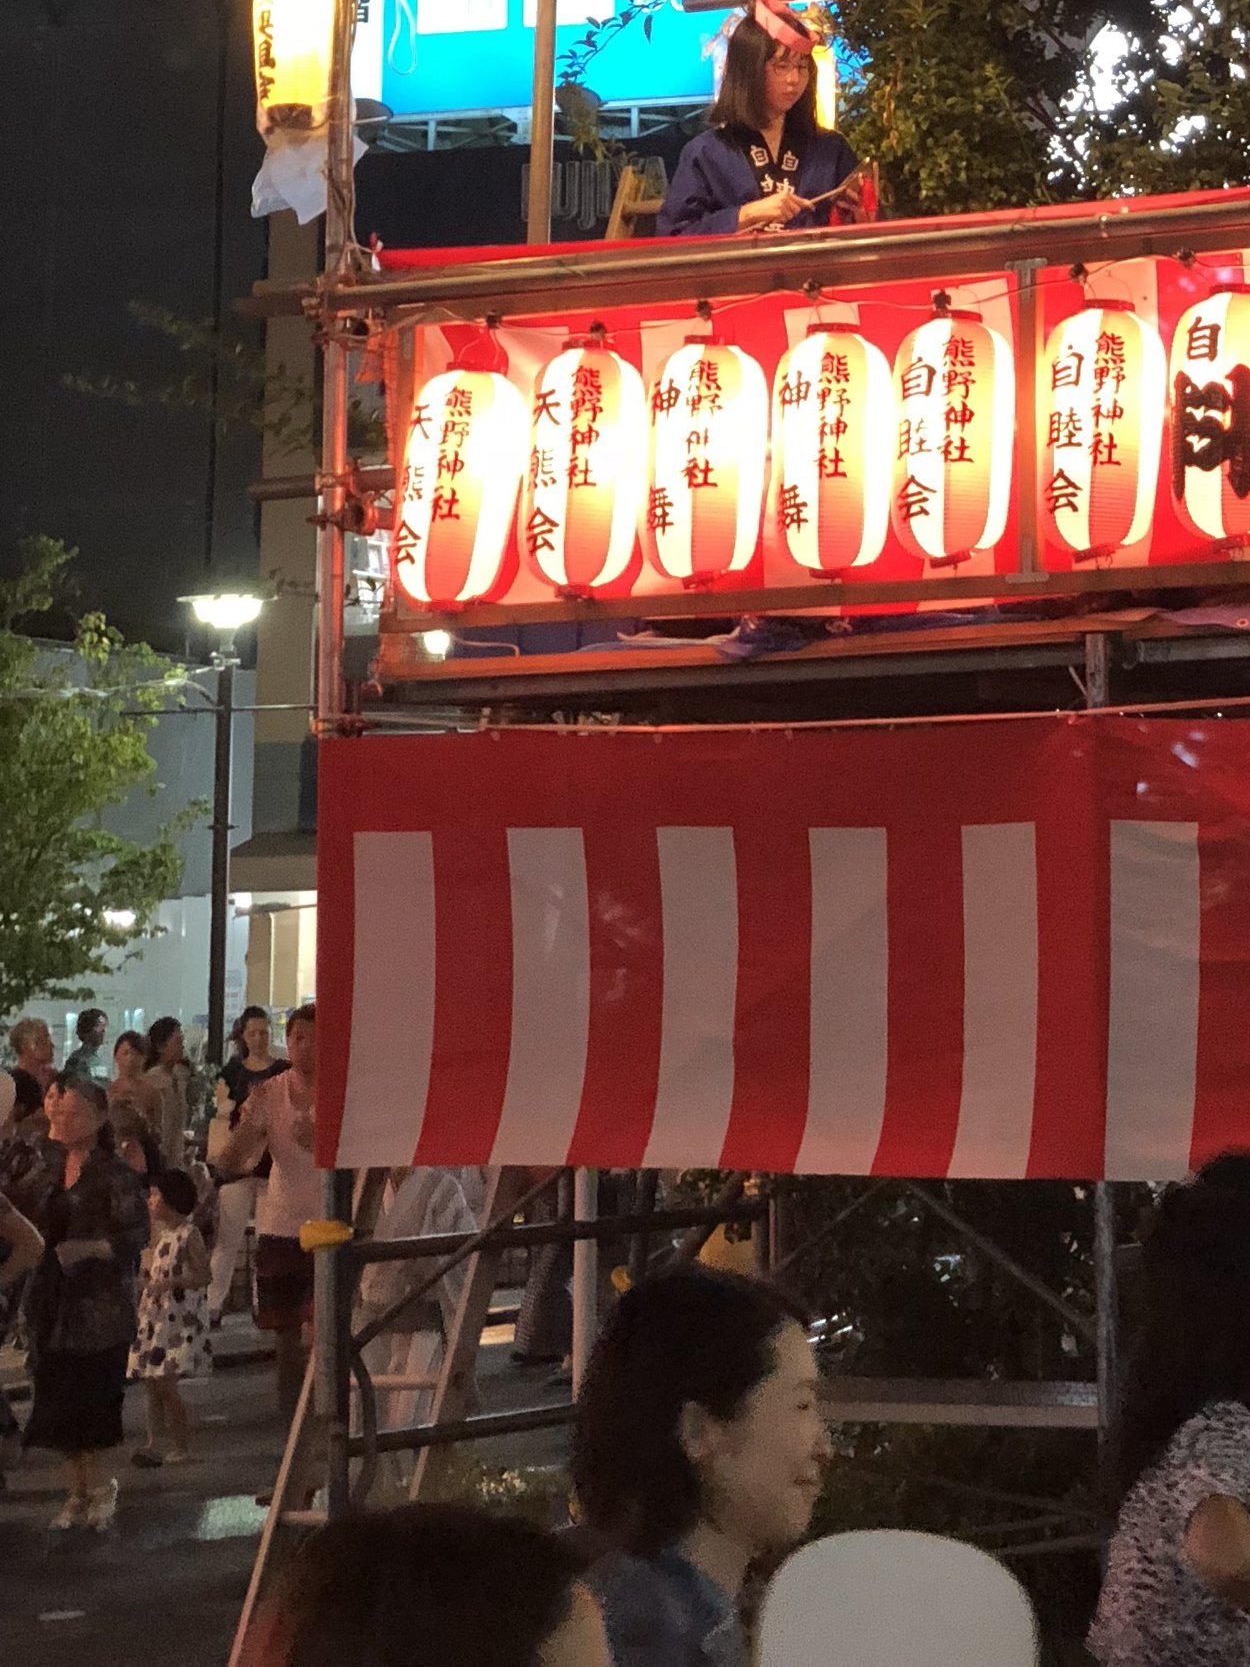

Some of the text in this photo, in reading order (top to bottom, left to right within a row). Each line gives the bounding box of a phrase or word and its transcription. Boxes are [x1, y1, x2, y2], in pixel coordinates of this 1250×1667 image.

[430, 386, 473, 523] 熊野神社
[564, 365, 603, 489] 熊野神社
[813, 351, 852, 480] 熊野神社
[937, 334, 977, 464] 熊野神社
[1087, 330, 1127, 468] 熊野神社
